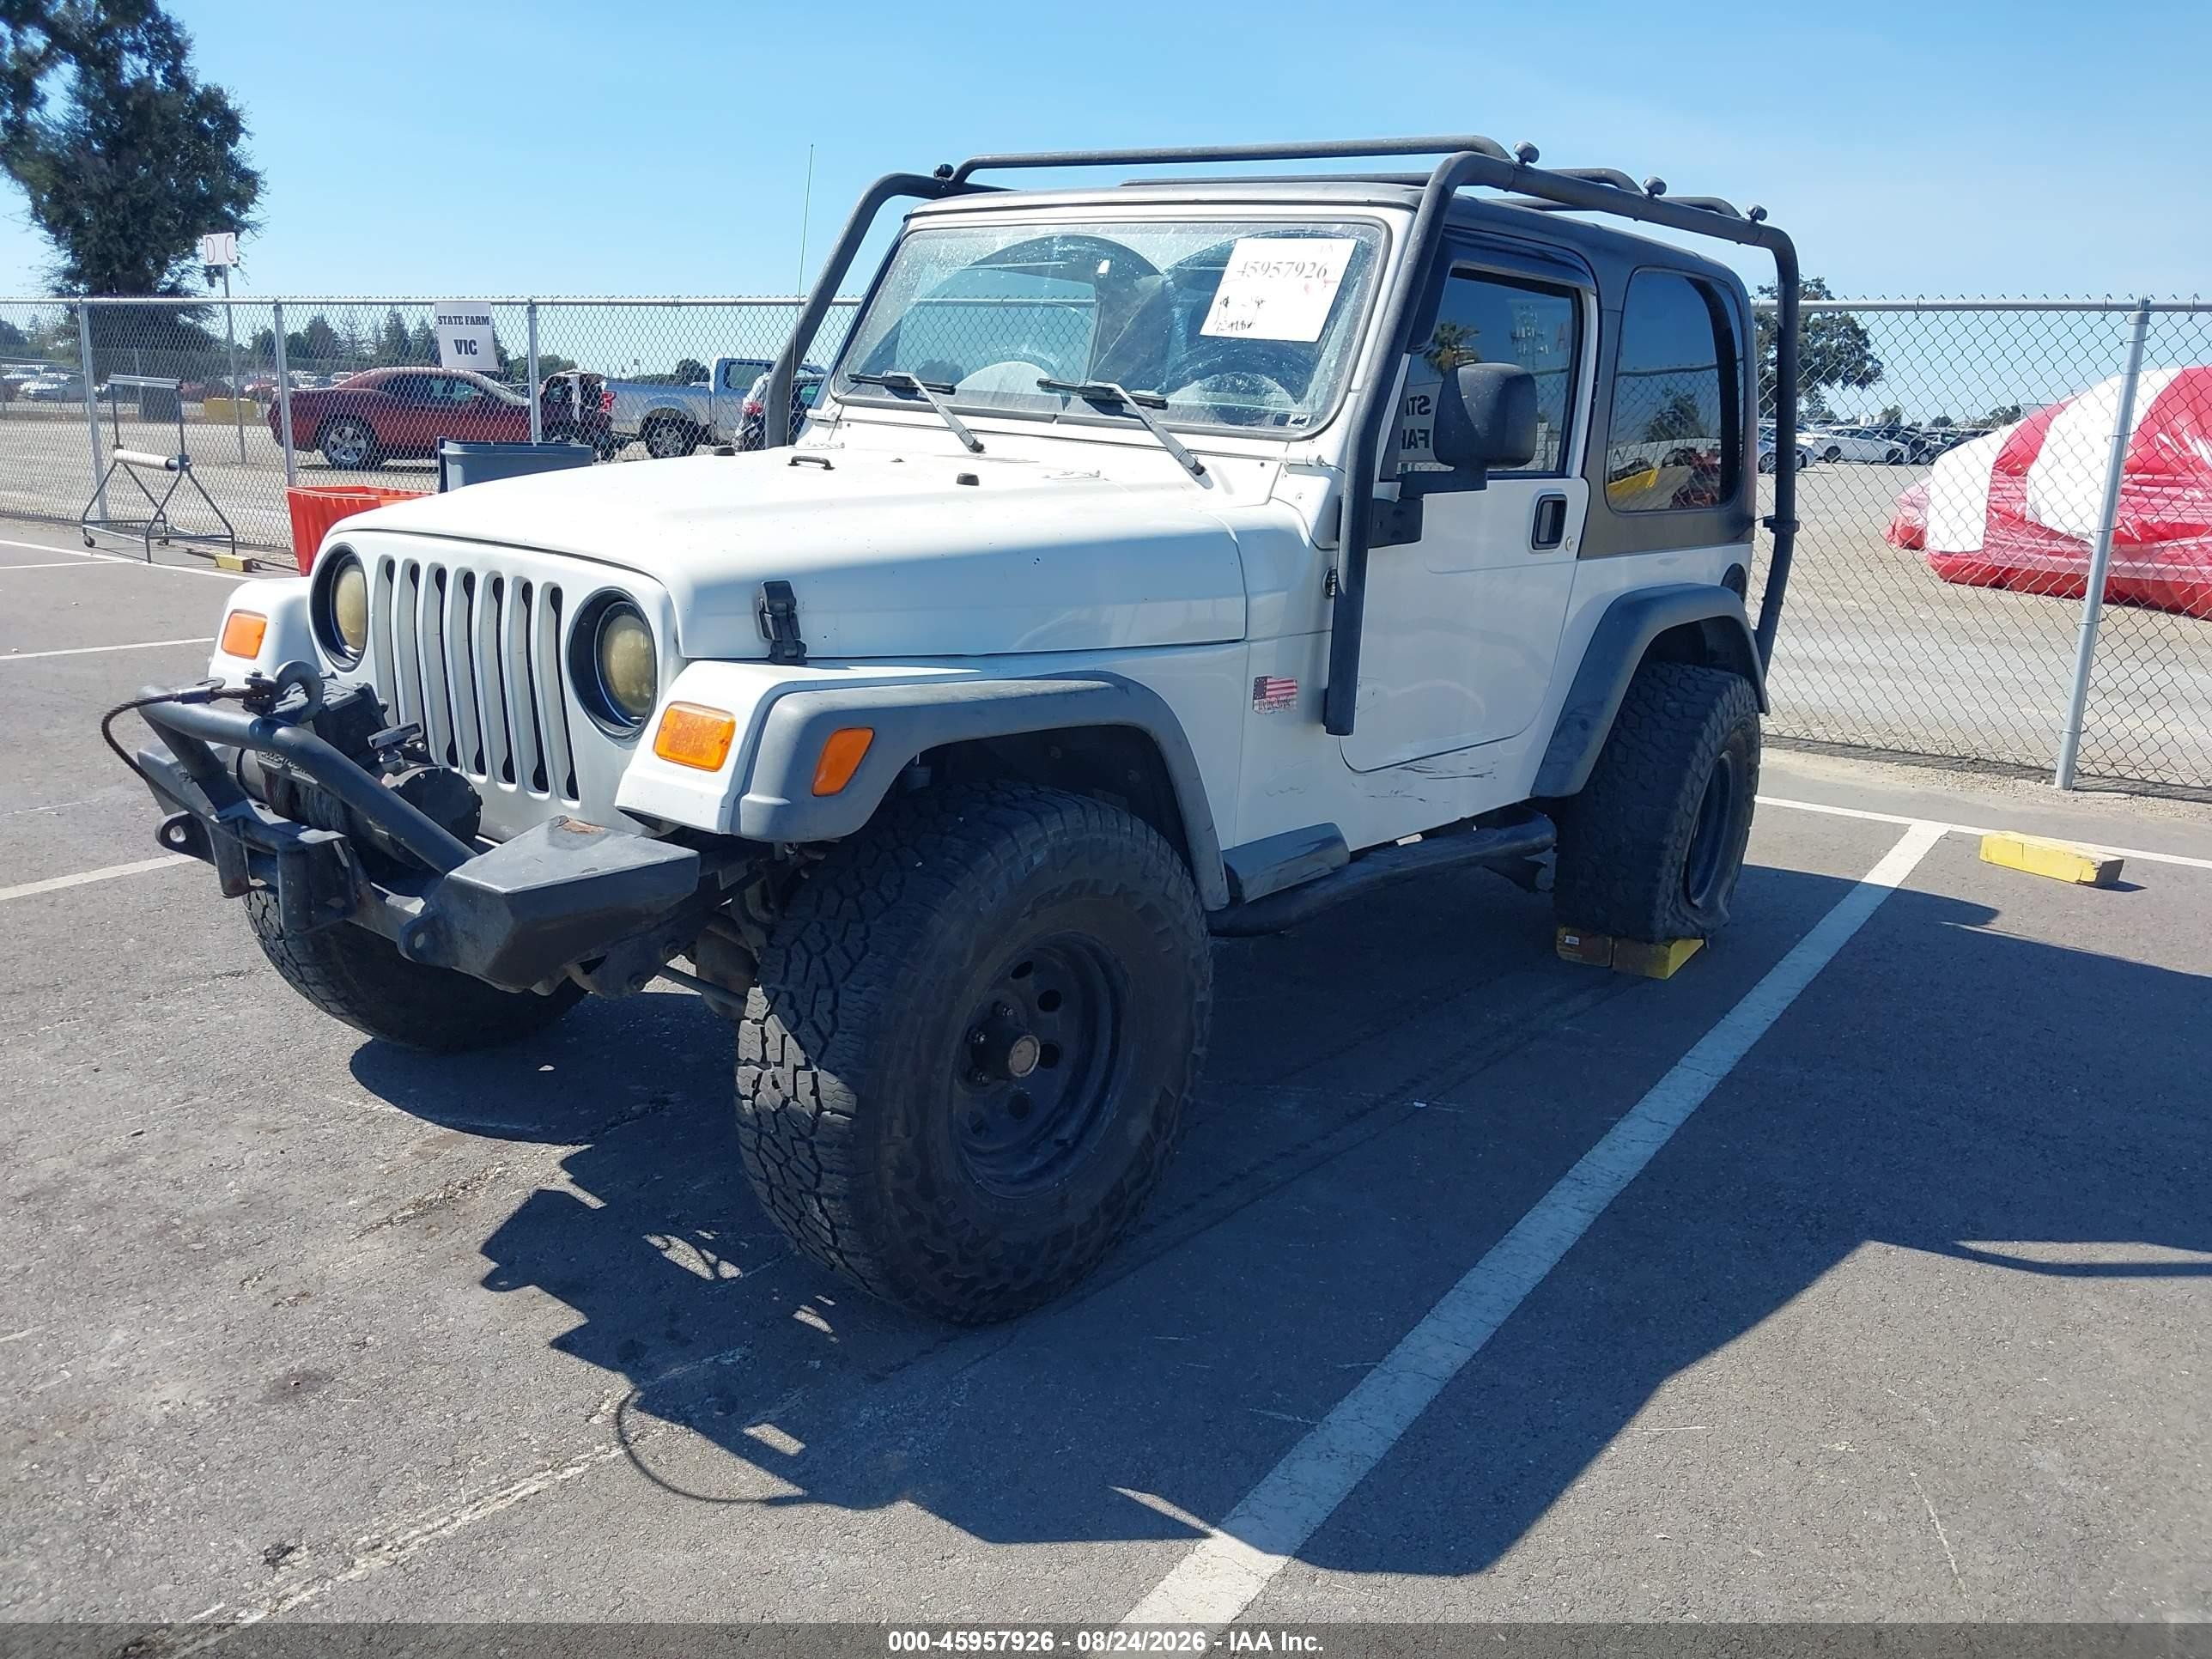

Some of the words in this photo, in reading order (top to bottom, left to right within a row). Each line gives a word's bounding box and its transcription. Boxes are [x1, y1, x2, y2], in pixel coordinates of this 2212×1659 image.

[438, 315, 464, 325] STATE
[465, 315, 489, 325] FARM
[453, 339, 477, 355] VIC
